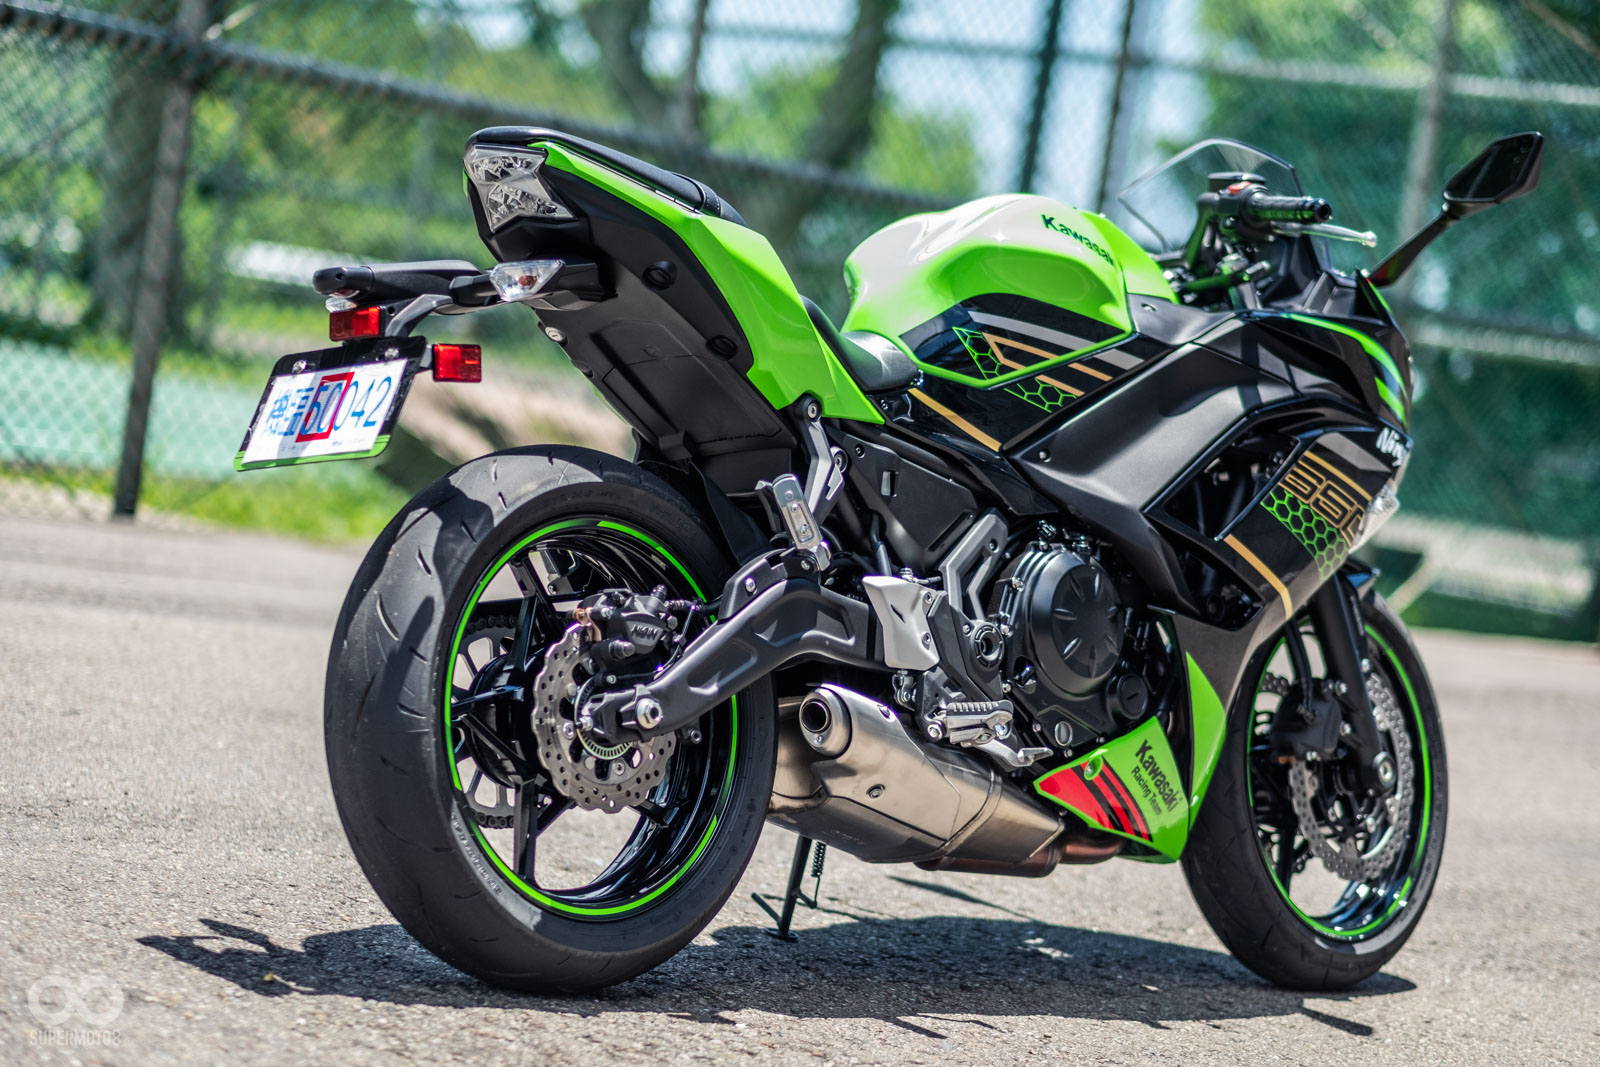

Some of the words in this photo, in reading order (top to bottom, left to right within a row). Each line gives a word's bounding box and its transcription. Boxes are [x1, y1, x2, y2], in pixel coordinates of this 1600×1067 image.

[1041, 213, 1114, 268] Kawasak
[1375, 426, 1408, 467] Ninj
[1130, 765, 1152, 799] Racing
[1147, 791, 1162, 816] Team
[1134, 738, 1183, 812] Kawasaki
